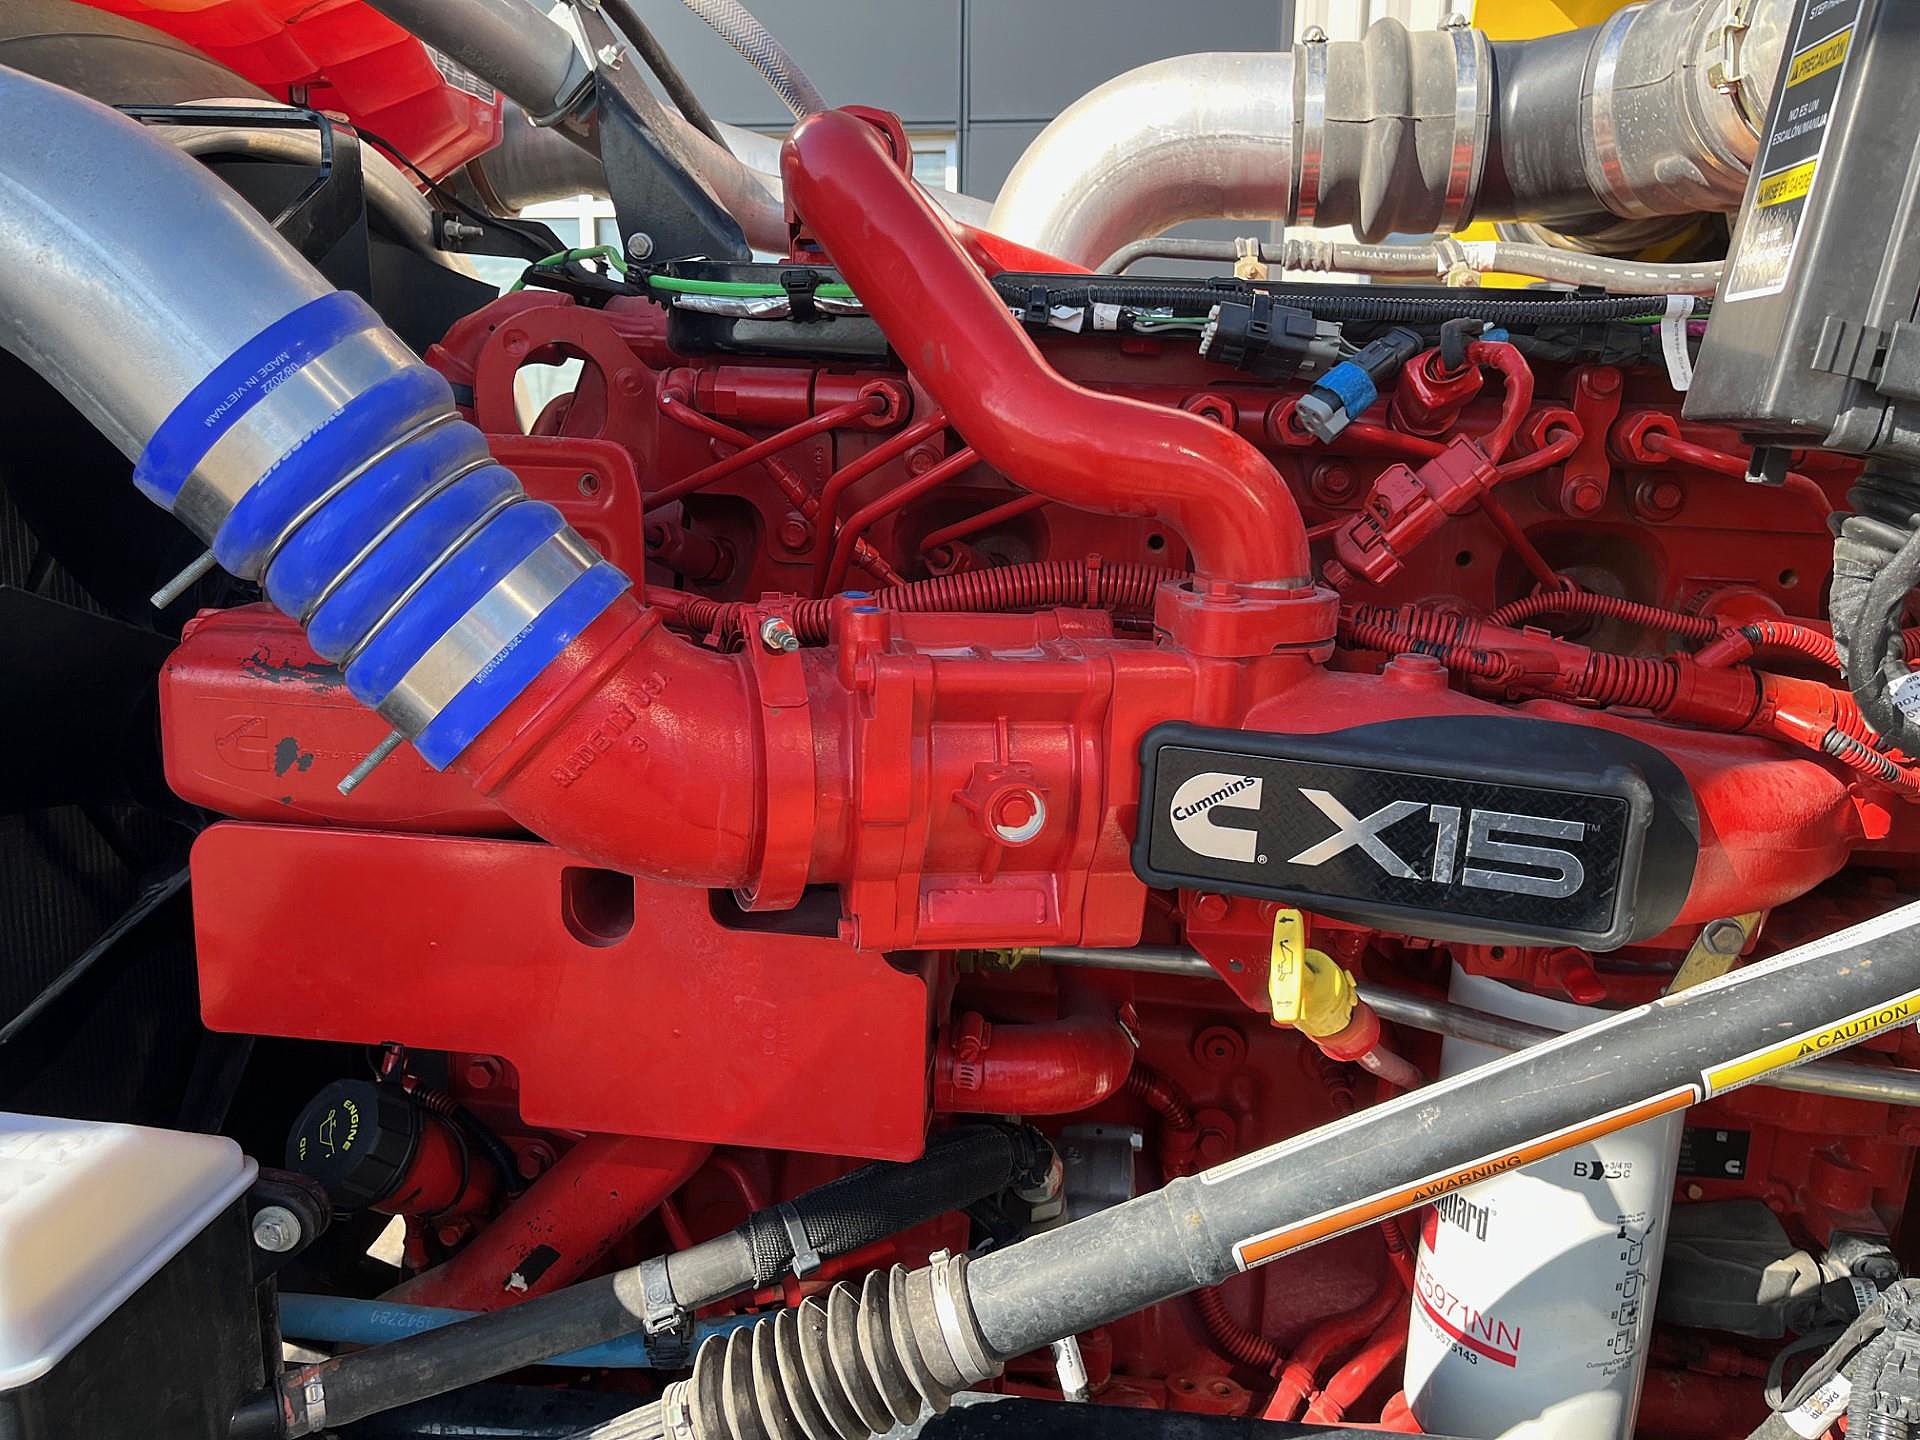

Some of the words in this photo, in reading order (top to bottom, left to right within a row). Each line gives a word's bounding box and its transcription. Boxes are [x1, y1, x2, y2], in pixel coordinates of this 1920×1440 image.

[1787, 107, 1799, 122] NO
[1799, 104, 1809, 118] ES
[1808, 98, 1820, 113] UN
[245, 375, 259, 389] IN
[257, 352, 290, 377] MADE
[204, 386, 248, 428] VIETNAM
[1172, 775, 1256, 822] Cummins
[1288, 787, 1585, 899] X15
[1816, 1003, 1909, 1049] CAUTION
[343, 1099, 359, 1151] ENGINE
[1426, 1155, 1522, 1197] WARNING
[1573, 1161, 1588, 1177] B
[1433, 1191, 1490, 1242] guard
